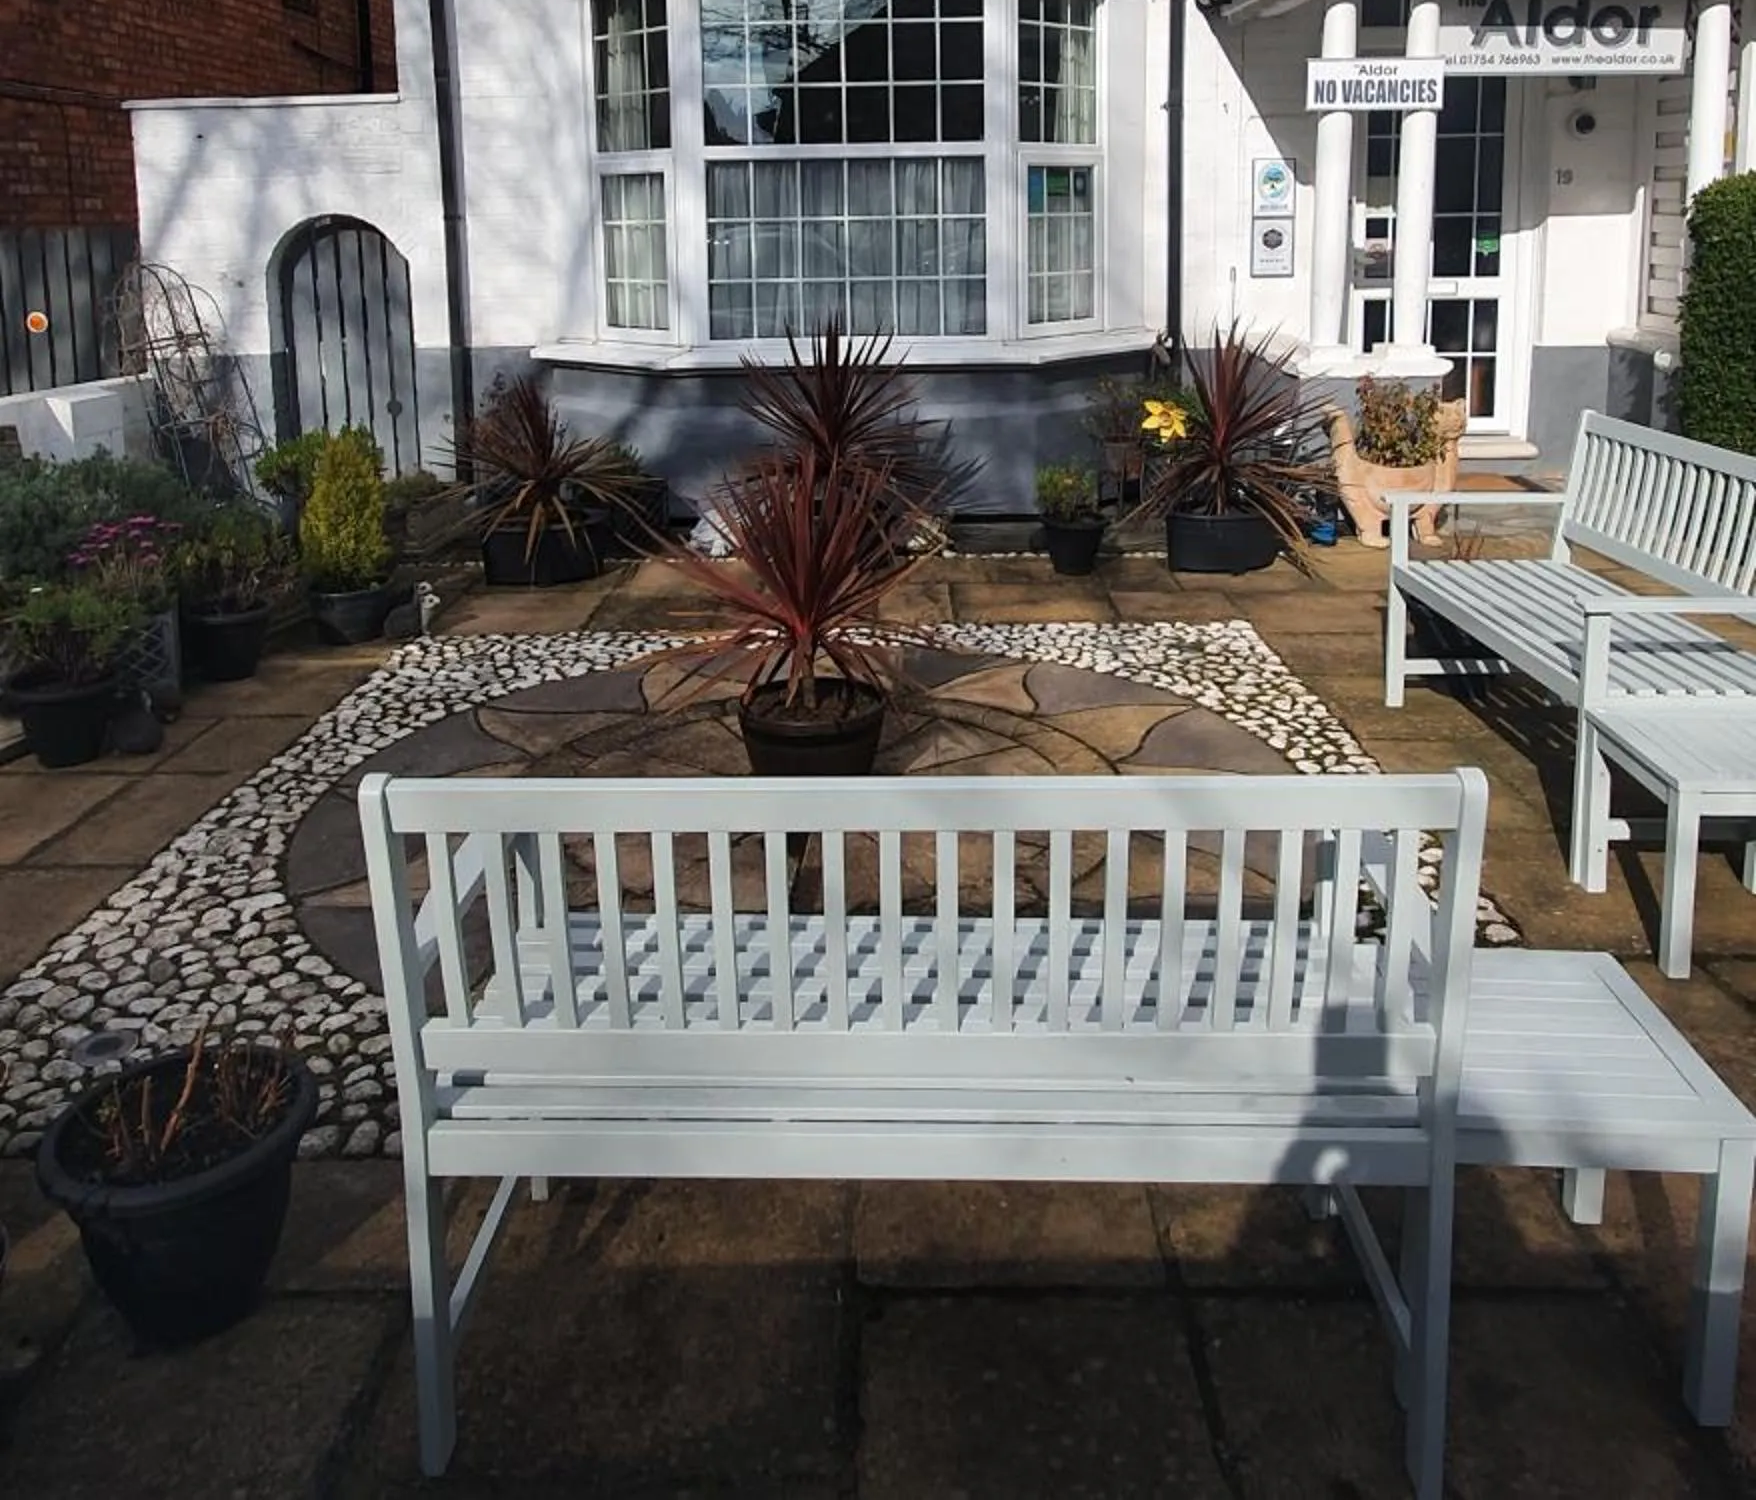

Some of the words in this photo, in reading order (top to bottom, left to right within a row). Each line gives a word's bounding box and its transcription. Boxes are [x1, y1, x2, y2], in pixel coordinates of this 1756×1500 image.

[1499, 53, 1541, 65] 766963
[1359, 64, 1398, 76] Aldor
[1314, 80, 1337, 104] NO
[1342, 79, 1438, 104] VACANCIES
[1556, 168, 1573, 185] 19
